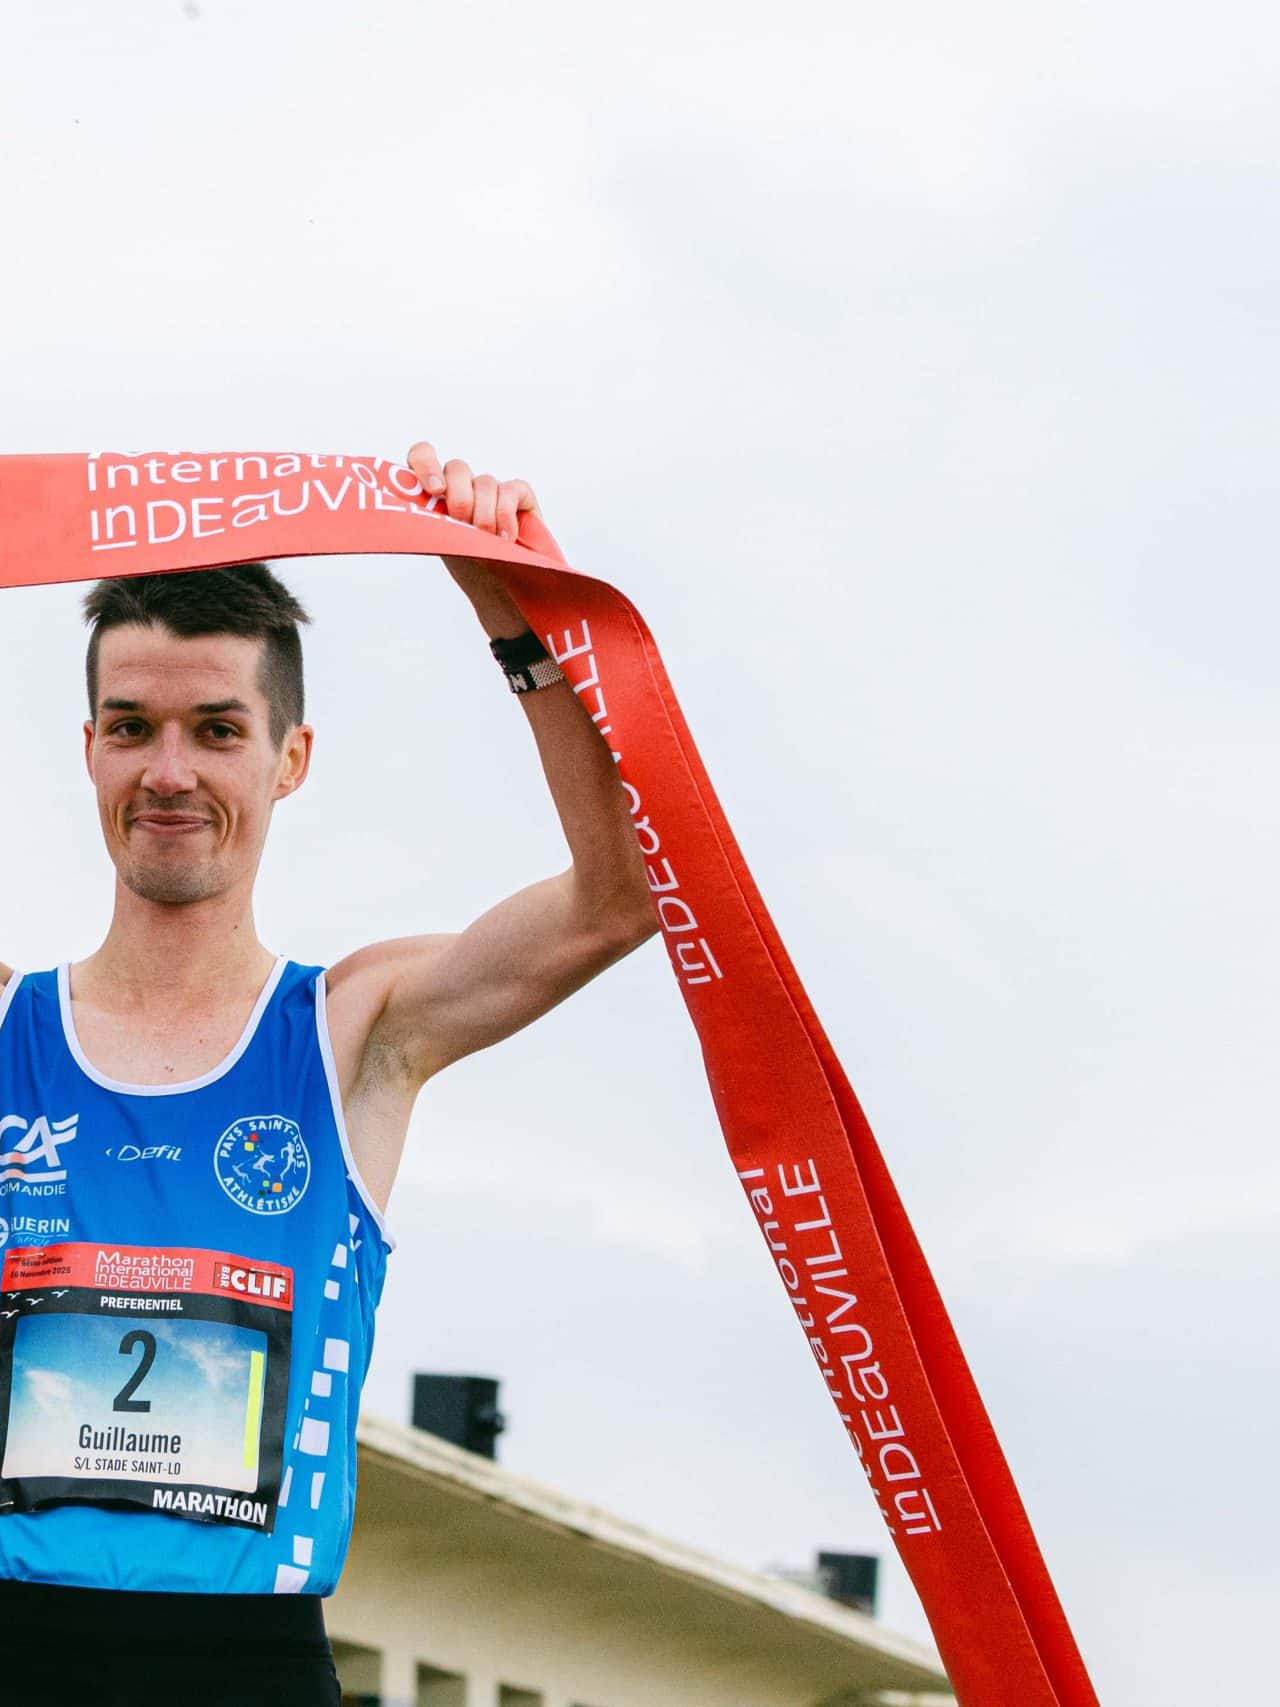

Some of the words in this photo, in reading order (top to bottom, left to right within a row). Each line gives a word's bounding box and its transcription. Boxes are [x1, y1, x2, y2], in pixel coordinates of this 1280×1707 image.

[220, 1127, 243, 1158] PAYS
[96, 1260, 194, 1278] International
[97, 1250, 194, 1267] Marathon
[220, 1265, 231, 1288] BAR
[231, 1269, 286, 1299] CLIF
[100, 1295, 184, 1311] PREFERENTIEL
[112, 1329, 157, 1413] 2
[79, 1424, 181, 1454] Guillaume
[74, 1456, 91, 1470] S/L
[95, 1458, 128, 1472] STADE
[131, 1460, 181, 1475] SAINT-LO
[152, 1488, 268, 1526] MARATHON
